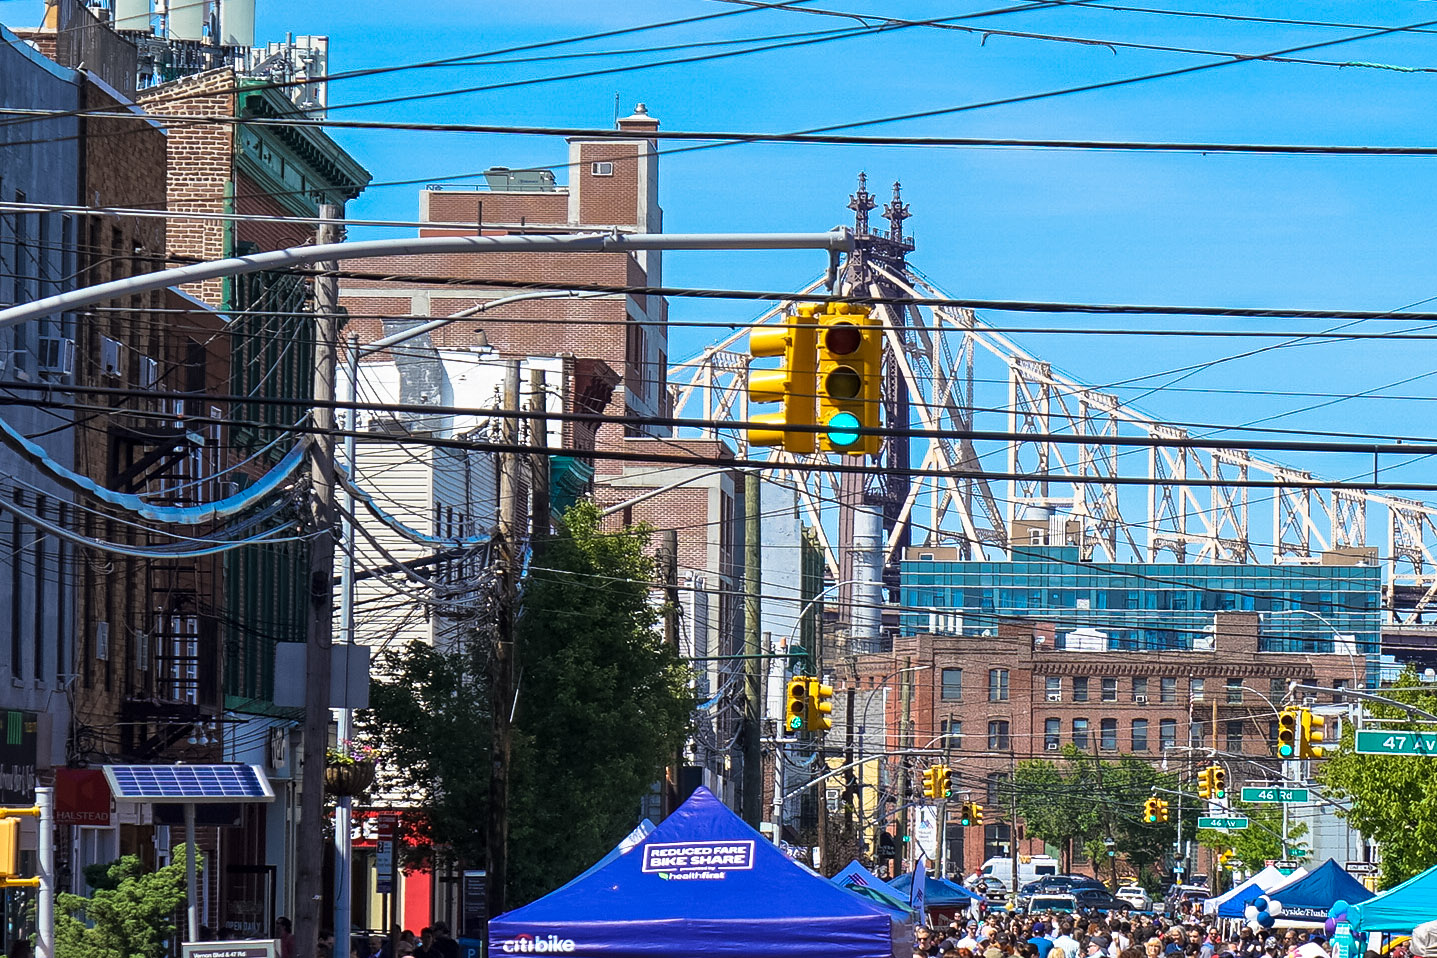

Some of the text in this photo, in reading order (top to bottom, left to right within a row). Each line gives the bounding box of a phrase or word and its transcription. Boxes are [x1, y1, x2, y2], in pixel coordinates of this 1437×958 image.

[1383, 736, 1436, 751] 47 Av
[1258, 791, 1293, 800] 46 Rd
[56, 811, 109, 821] HALSTEAD
[650, 846, 747, 857] REDUCED FARE
[650, 855, 746, 867] BIKE SHARE
[669, 871, 725, 880] healthfirst
